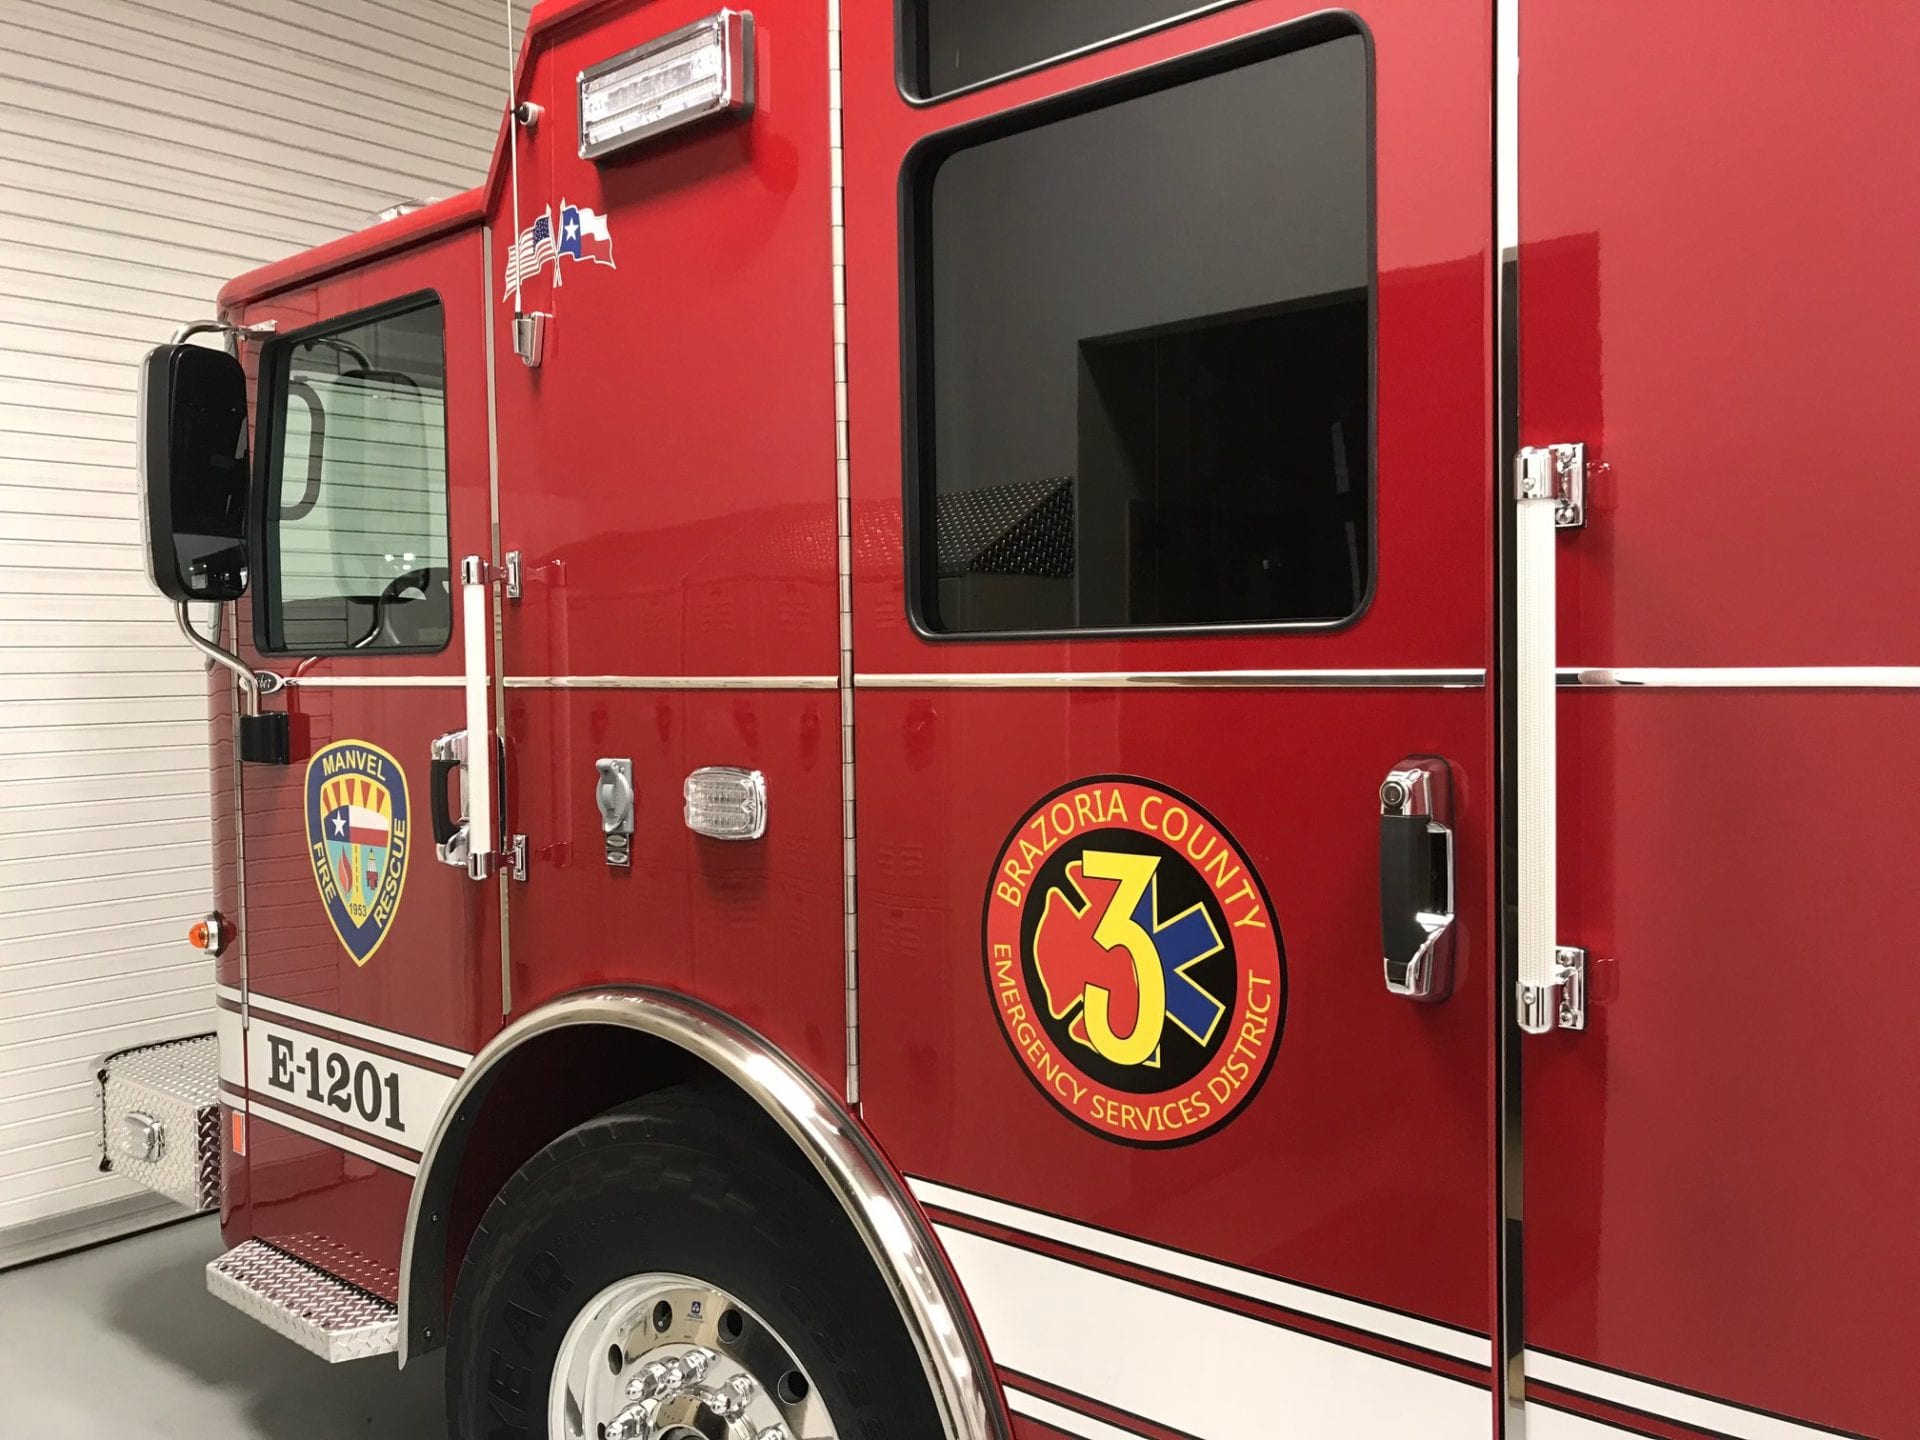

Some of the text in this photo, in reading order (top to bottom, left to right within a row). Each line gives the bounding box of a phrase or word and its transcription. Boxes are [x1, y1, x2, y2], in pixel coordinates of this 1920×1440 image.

[322, 750, 387, 782] MANVEL
[314, 843, 336, 902] FIRE
[349, 903, 367, 917] 1953
[373, 818, 406, 929] RESCUE
[997, 789, 1266, 930] BRAZORIA COUNTY
[1082, 850, 1167, 1066] 3
[267, 1034, 404, 1132] E-1201
[993, 944, 1273, 1132] EMERGENCY SERVICES DISTRICT
